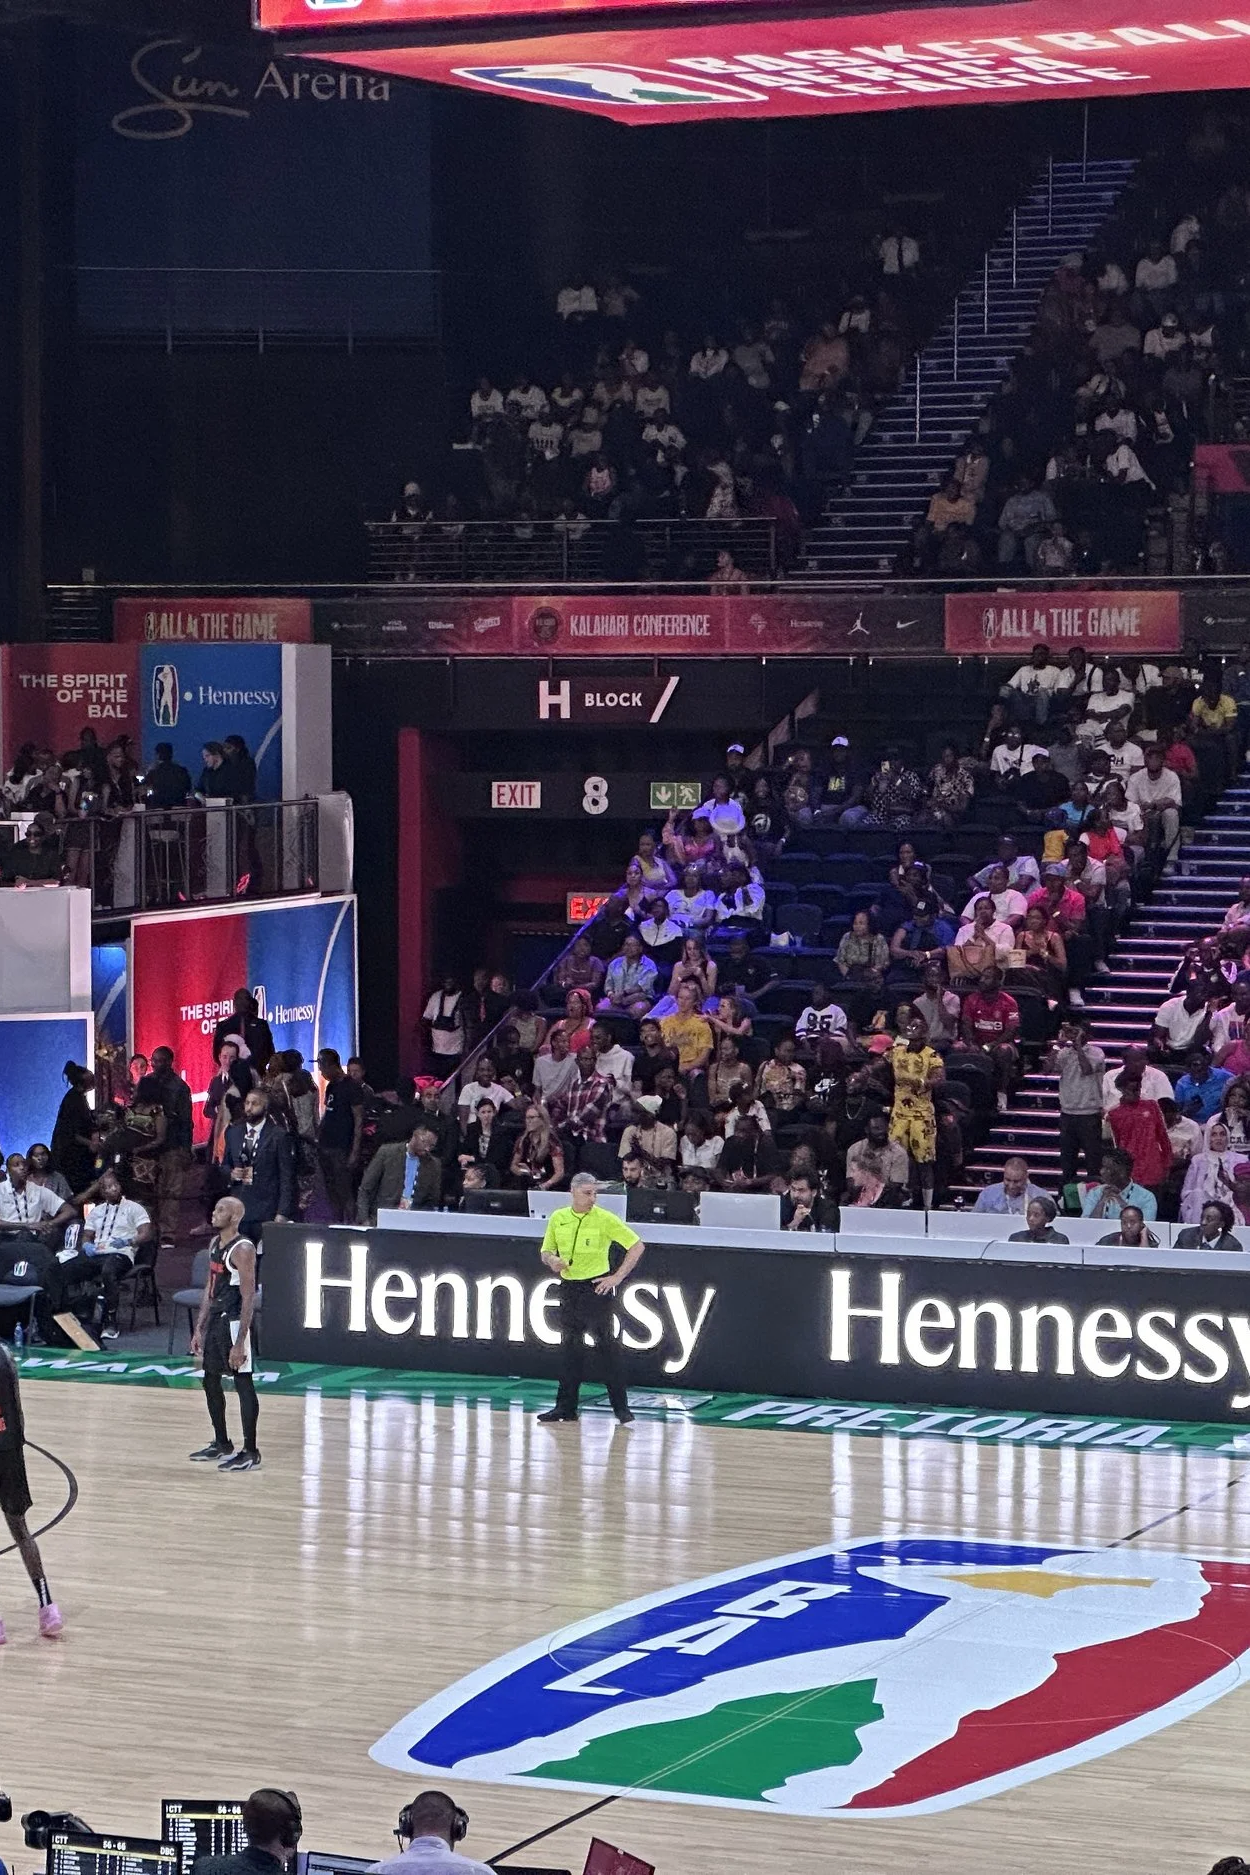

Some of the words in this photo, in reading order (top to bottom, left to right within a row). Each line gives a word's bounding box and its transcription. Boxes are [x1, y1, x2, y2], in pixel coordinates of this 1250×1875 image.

[734, 56, 1089, 88] AFRICA
[779, 67, 1152, 99] LEAGUE
[111, 39, 250, 140] Sun
[254, 60, 391, 101] Arena
[202, 612, 231, 640] THE
[233, 612, 278, 641] GAME
[570, 616, 630, 637] KALAHARI
[633, 613, 711, 637] CONFERENCE
[1049, 608, 1084, 637] THE
[1088, 606, 1141, 637] GAME
[19, 675, 58, 688] THE
[62, 674, 127, 688] SPIRIT
[56, 689, 87, 703] OF
[89, 689, 127, 703] THE
[199, 686, 280, 709] Hennessy
[538, 680, 571, 719] H
[584, 693, 643, 707] BLOCK
[88, 704, 128, 718] BAL
[495, 784, 537, 807] EXIT
[582, 776, 609, 815] 8
[180, 1005, 203, 1021] THE
[204, 1000, 234, 1018] SPIRI
[275, 1004, 316, 1025] Hennessy
[303, 1241, 716, 1375] Hennesy
[14, 1356, 282, 1383] WANA
[542, 1579, 851, 1697] BAL
